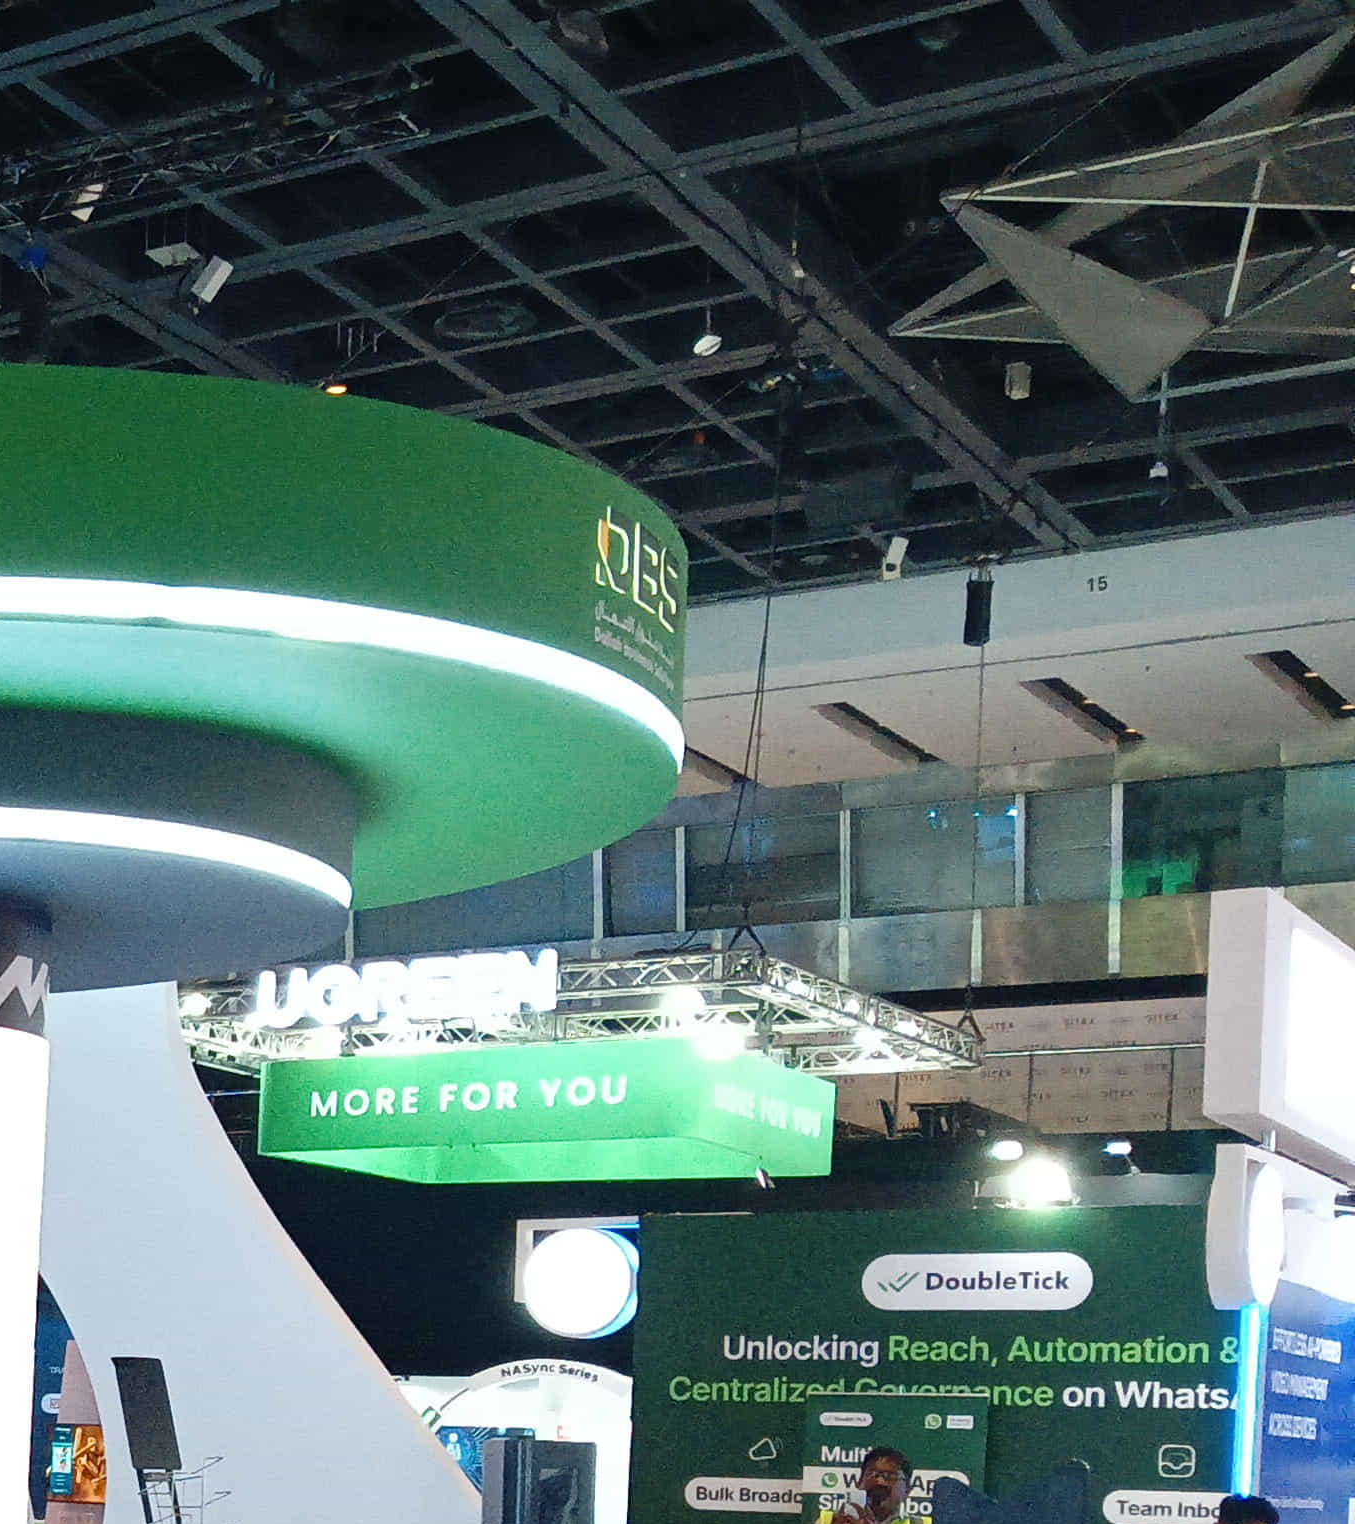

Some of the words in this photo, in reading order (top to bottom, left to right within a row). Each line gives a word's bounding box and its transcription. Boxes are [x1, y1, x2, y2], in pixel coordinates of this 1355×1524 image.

[595, 506, 679, 633] DBS
[1086, 575, 1108, 593] 15
[252, 948, 559, 1028] UGREEN
[309, 1085, 420, 1118] MORE
[438, 1078, 519, 1114] FOR
[538, 1074, 629, 1107] YOU
[925, 1271, 1070, 1290] DoubleTick
[723, 1334, 880, 1368] Unlocking
[888, 1335, 997, 1367] Reach,
[1007, 1335, 1210, 1364] Automation
[1219, 1336, 1240, 1364] &
[500, 1363, 555, 1378] NASync
[559, 1364, 598, 1382] Series
[1062, 1385, 1106, 1408] on
[1114, 1381, 1239, 1410] Whats
[821, 1446, 874, 1463] Mult
[696, 1486, 733, 1501] Bulk
[740, 1487, 803, 1504] Broadc
[1116, 1500, 1172, 1516] Team
[1177, 1502, 1220, 1518] Inbo
